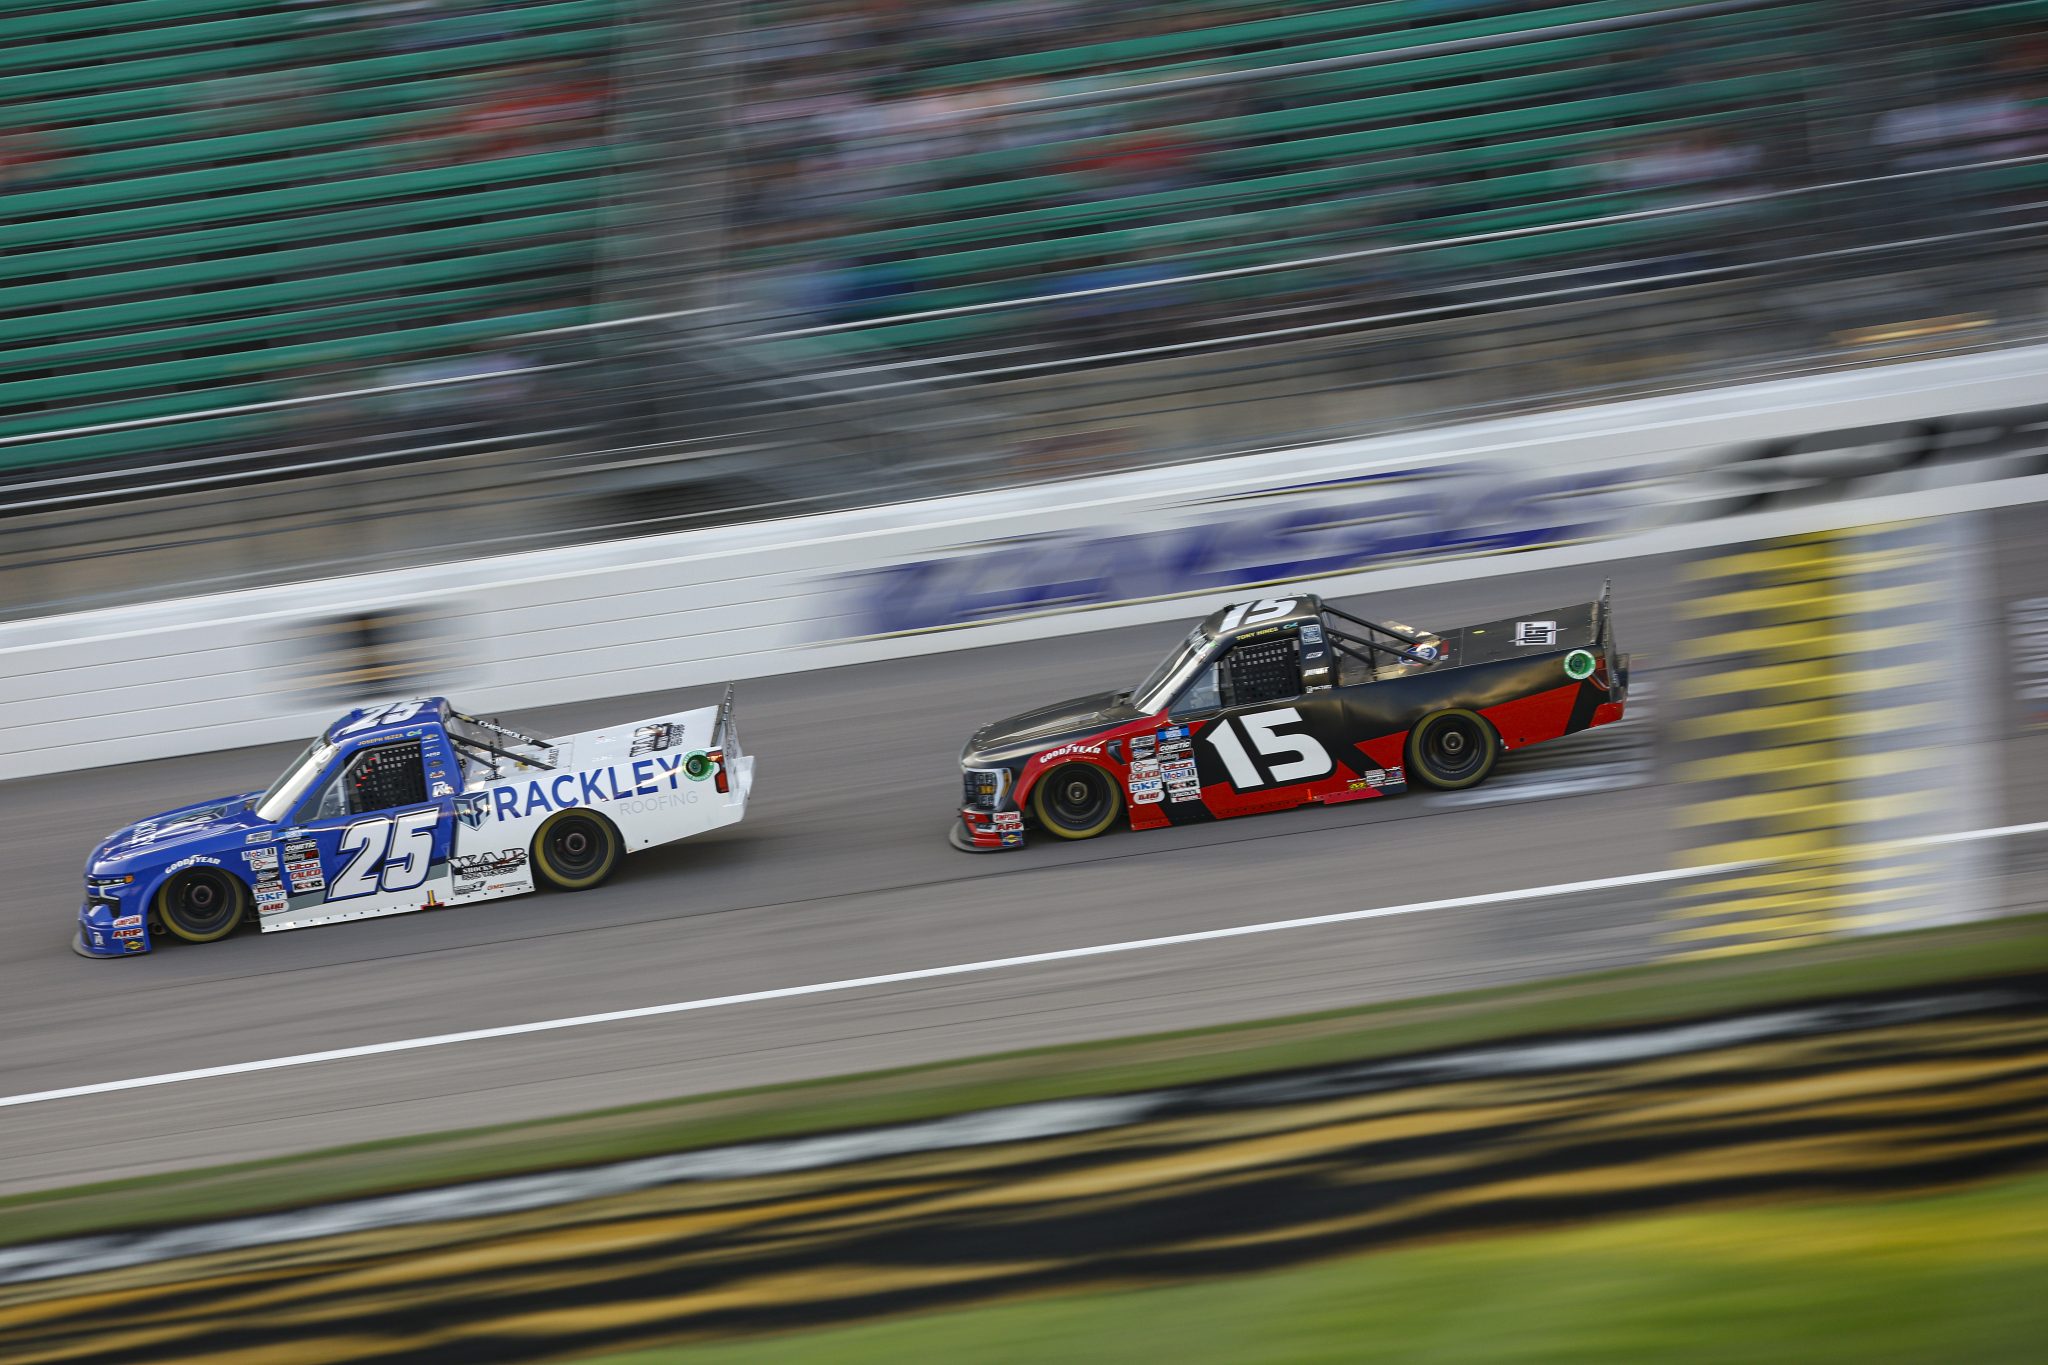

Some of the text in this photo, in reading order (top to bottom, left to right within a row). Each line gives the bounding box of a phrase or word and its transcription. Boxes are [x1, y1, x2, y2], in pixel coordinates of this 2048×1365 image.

[1219, 593, 1307, 633] 15
[332, 698, 432, 741] 25
[477, 719, 534, 745] CHEVROLET
[1039, 743, 1102, 764] GOODYEAR
[1160, 741, 1191, 752] COMETIC
[1205, 707, 1333, 789] 15
[1163, 770, 1186, 780] Mobil
[492, 753, 682, 822] RACKLEY
[1131, 780, 1161, 791] SKF
[619, 790, 698, 816] ROOFING
[997, 822, 1022, 831] ARP
[244, 849, 266, 858] Mobil
[286, 841, 316, 852] COMETIC
[327, 806, 441, 902] 25
[165, 854, 221, 874] GOODYEAR
[290, 868, 321, 879] CALICO
[256, 891, 284, 901] SKF
[114, 928, 142, 938] ARP
